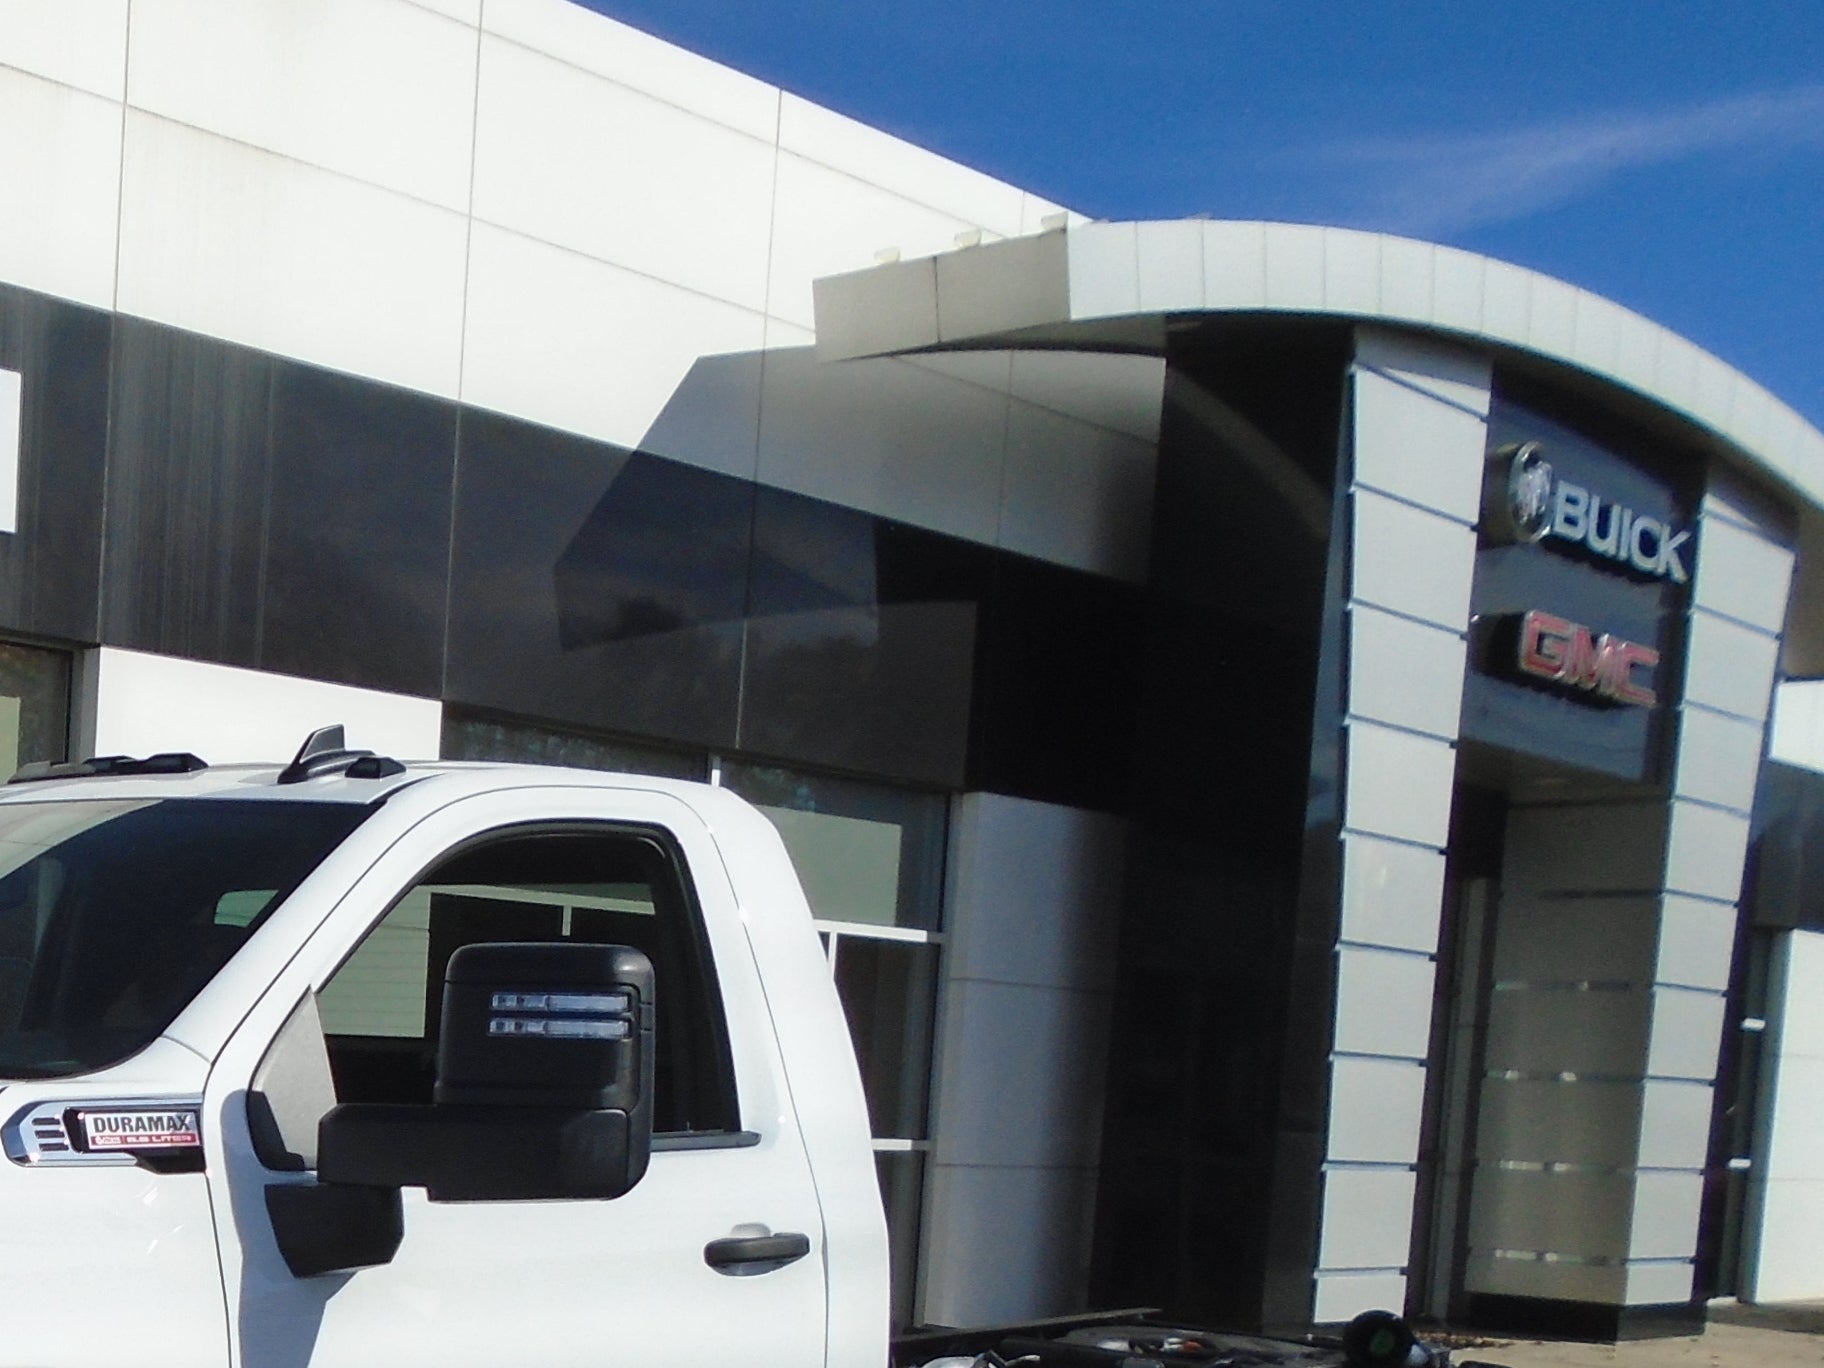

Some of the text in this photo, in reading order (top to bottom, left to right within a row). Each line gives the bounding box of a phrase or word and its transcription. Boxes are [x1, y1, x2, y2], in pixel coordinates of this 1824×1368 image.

[1552, 479, 1692, 583] BUICK
[1519, 609, 1660, 708] GMC
[92, 1115, 191, 1133] DURAMAX
